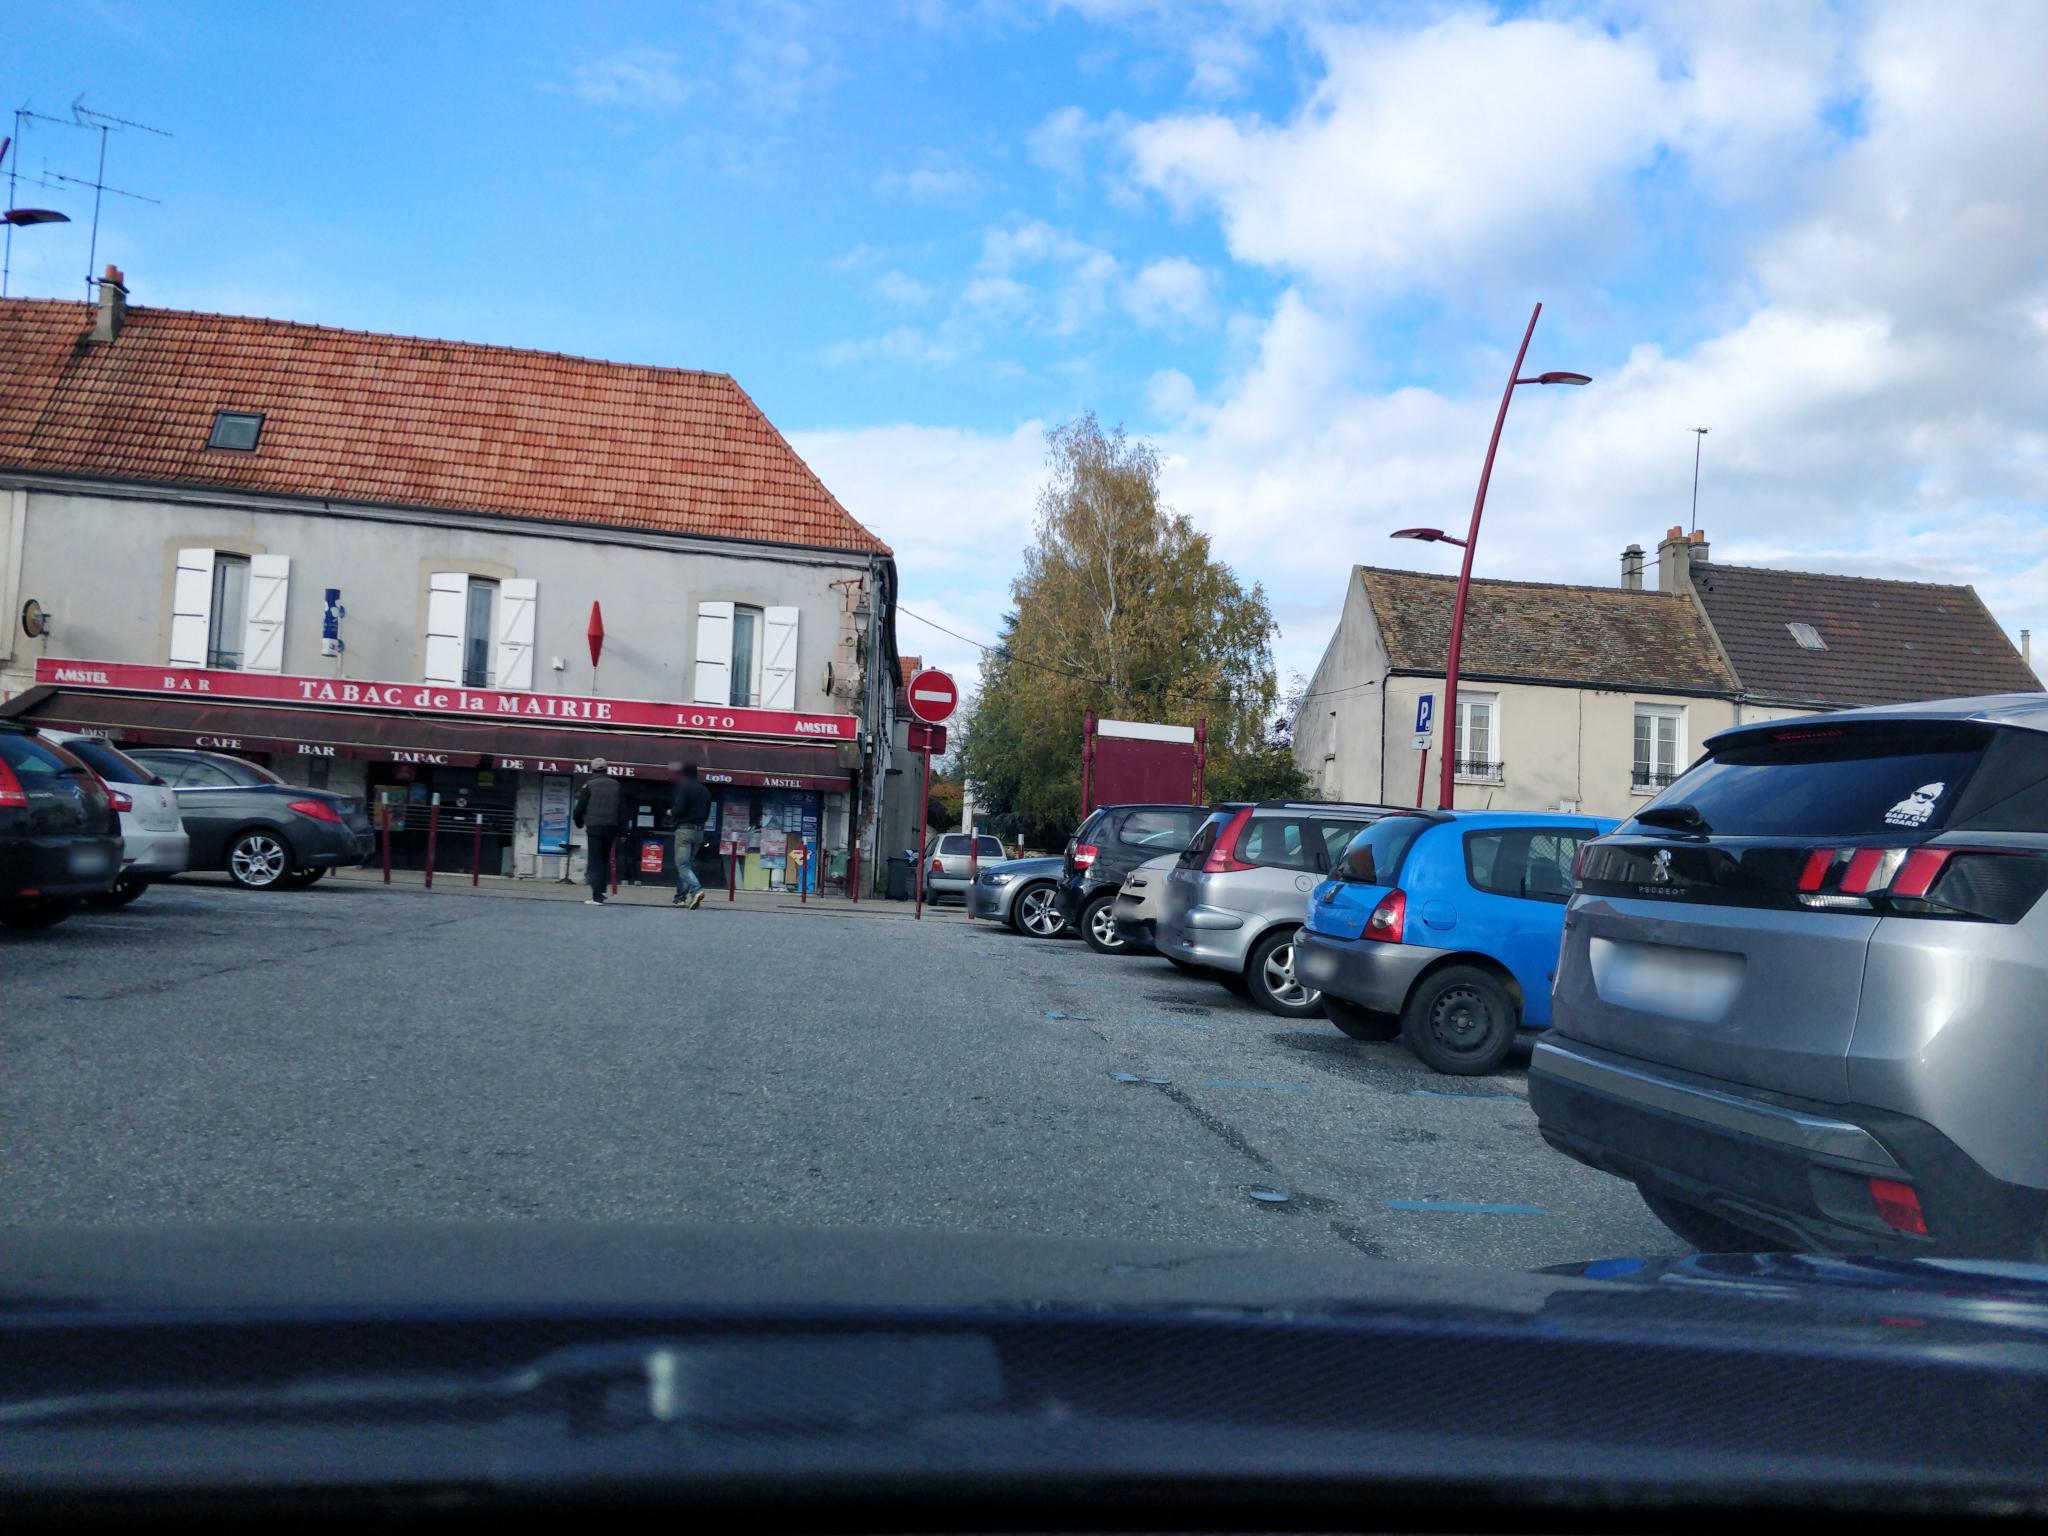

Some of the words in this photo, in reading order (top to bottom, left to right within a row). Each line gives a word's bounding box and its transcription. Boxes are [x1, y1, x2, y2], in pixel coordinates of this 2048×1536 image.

[54, 668, 109, 684] AMSTEL
[163, 677, 211, 691] BAR
[299, 681, 403, 705] TABAC
[414, 689, 449, 708] de
[458, 691, 485, 711] la
[496, 695, 612, 720] MAIRIE
[676, 713, 735, 728] LOTO
[1419, 701, 1429, 727] P
[794, 720, 841, 735] AMSTEL
[195, 736, 242, 750] CAFE
[298, 744, 336, 757] BAR
[501, 758, 525, 770] DE
[537, 761, 559, 773] LA
[573, 763, 636, 777] MRIE
[763, 777, 802, 788] AMSTEL
[1884, 812, 1911, 820] BABY
[1911, 815, 1929, 823] ON
[1884, 817, 1919, 827] BOARD
[1638, 886, 1687, 895] PEUGEOT
